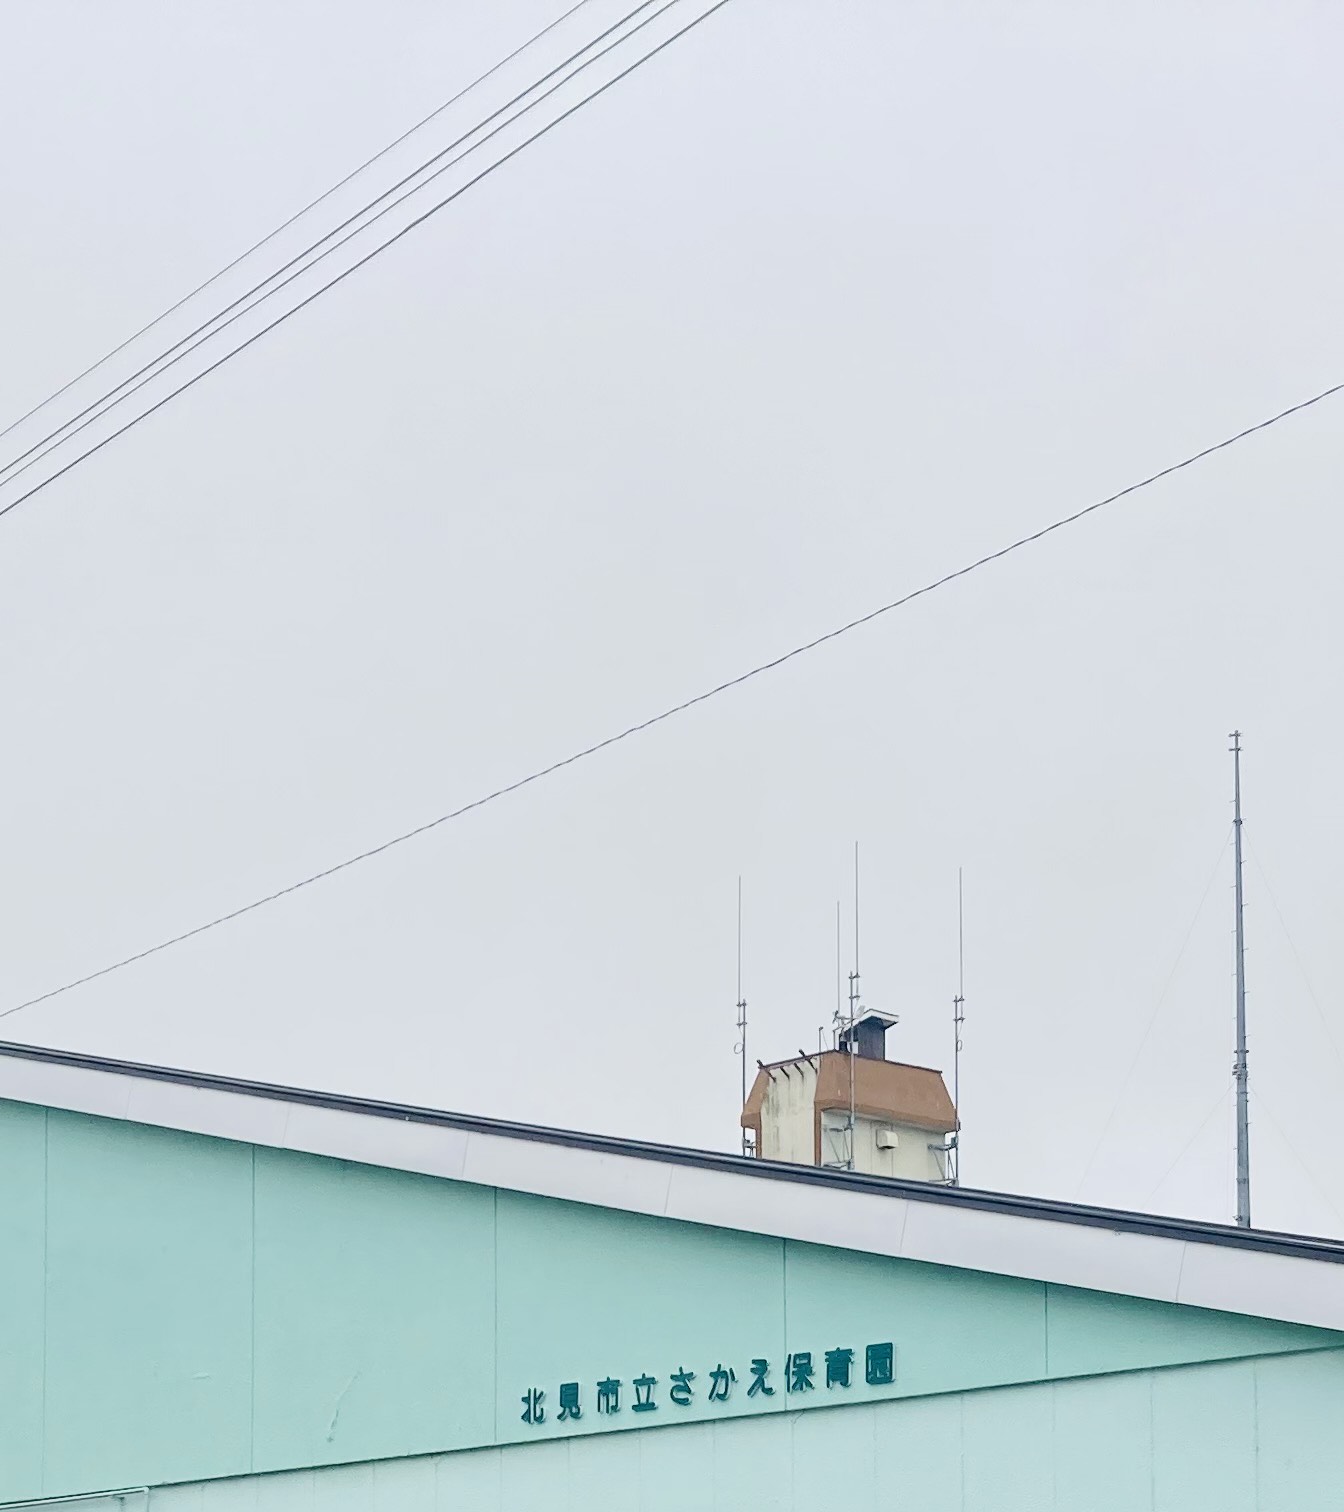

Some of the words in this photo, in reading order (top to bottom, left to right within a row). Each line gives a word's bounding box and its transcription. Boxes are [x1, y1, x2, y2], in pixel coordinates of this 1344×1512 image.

[520, 1341, 895, 1424] 北見市立さかえ保育園
